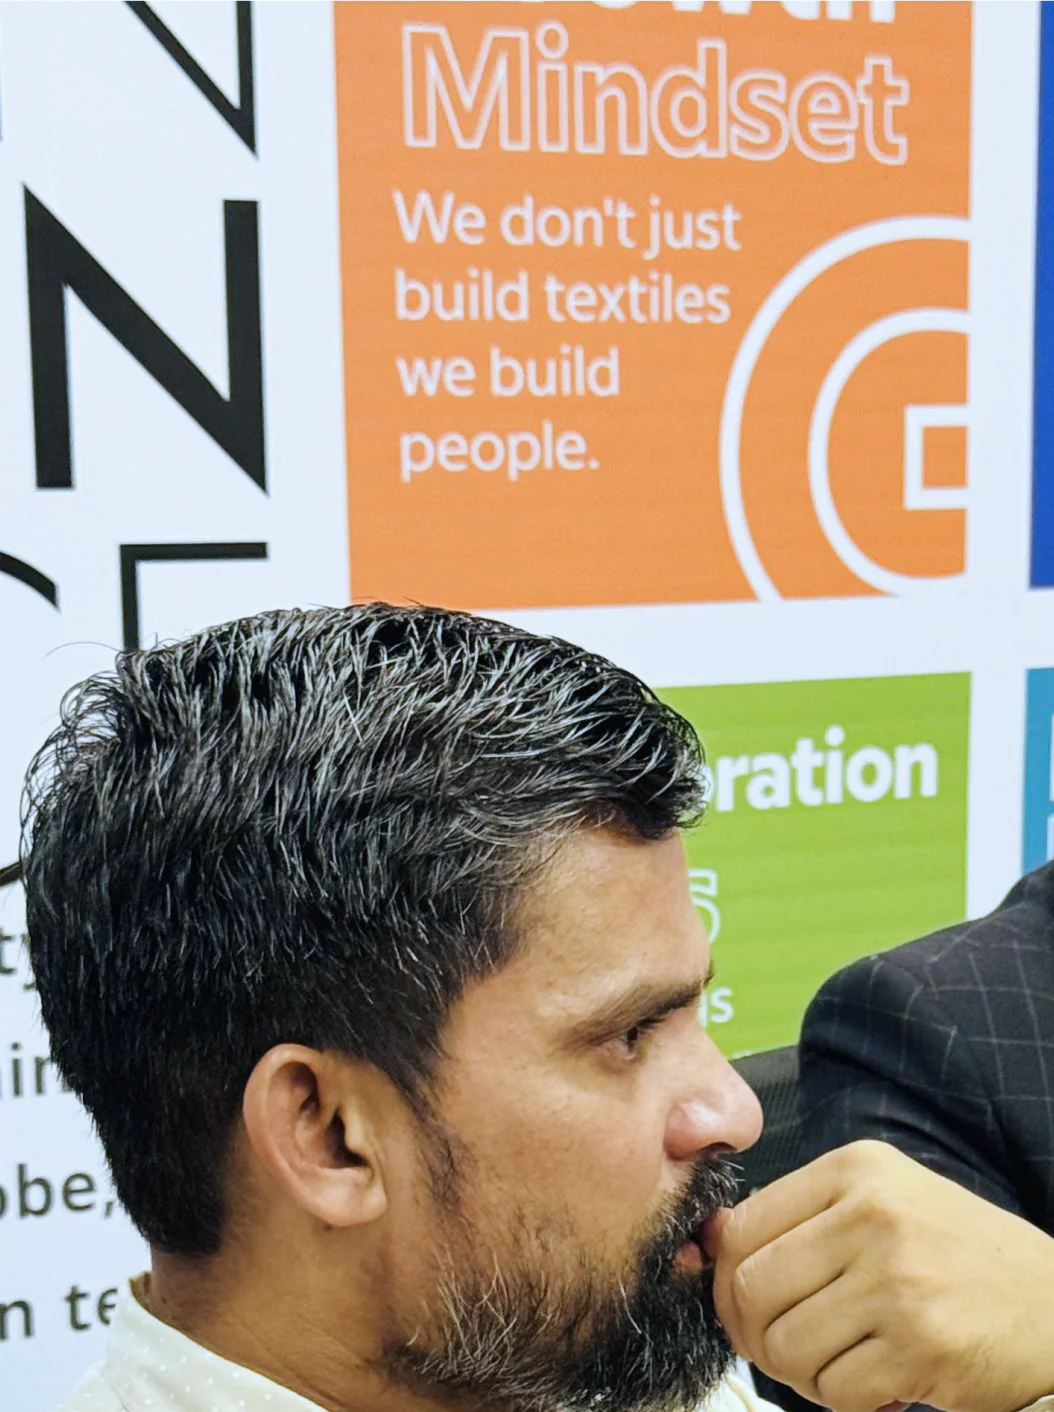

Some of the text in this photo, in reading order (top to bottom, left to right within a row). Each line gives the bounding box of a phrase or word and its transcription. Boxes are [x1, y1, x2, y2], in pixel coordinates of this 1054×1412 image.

[401, 20, 909, 165] Mindset
[393, 190, 742, 260] We don't just
[396, 268, 731, 324] build textiles
[396, 344, 621, 397] we build
[399, 419, 600, 482] people.
